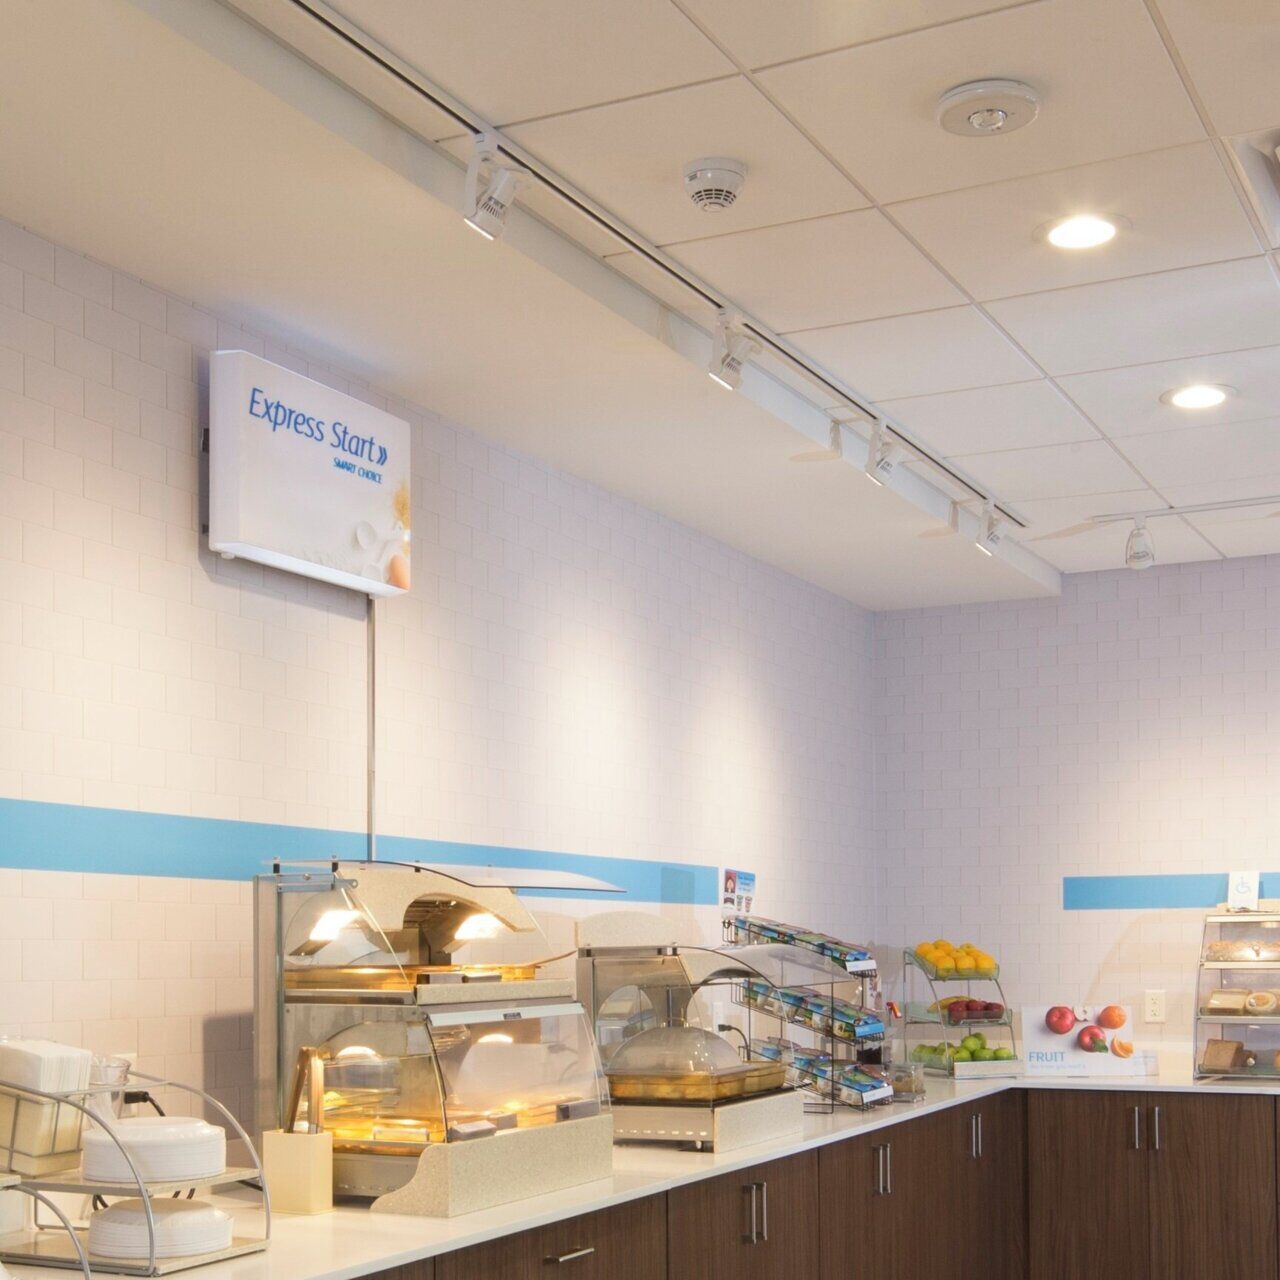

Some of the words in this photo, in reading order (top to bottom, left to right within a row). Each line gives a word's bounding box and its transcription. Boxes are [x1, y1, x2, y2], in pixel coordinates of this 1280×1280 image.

[249, 387, 325, 442] Express
[330, 421, 376, 463] Start
[333, 457, 357, 474] SMART
[357, 467, 383, 484] CHOICE
[1028, 1051, 1066, 1062] FRUIT
